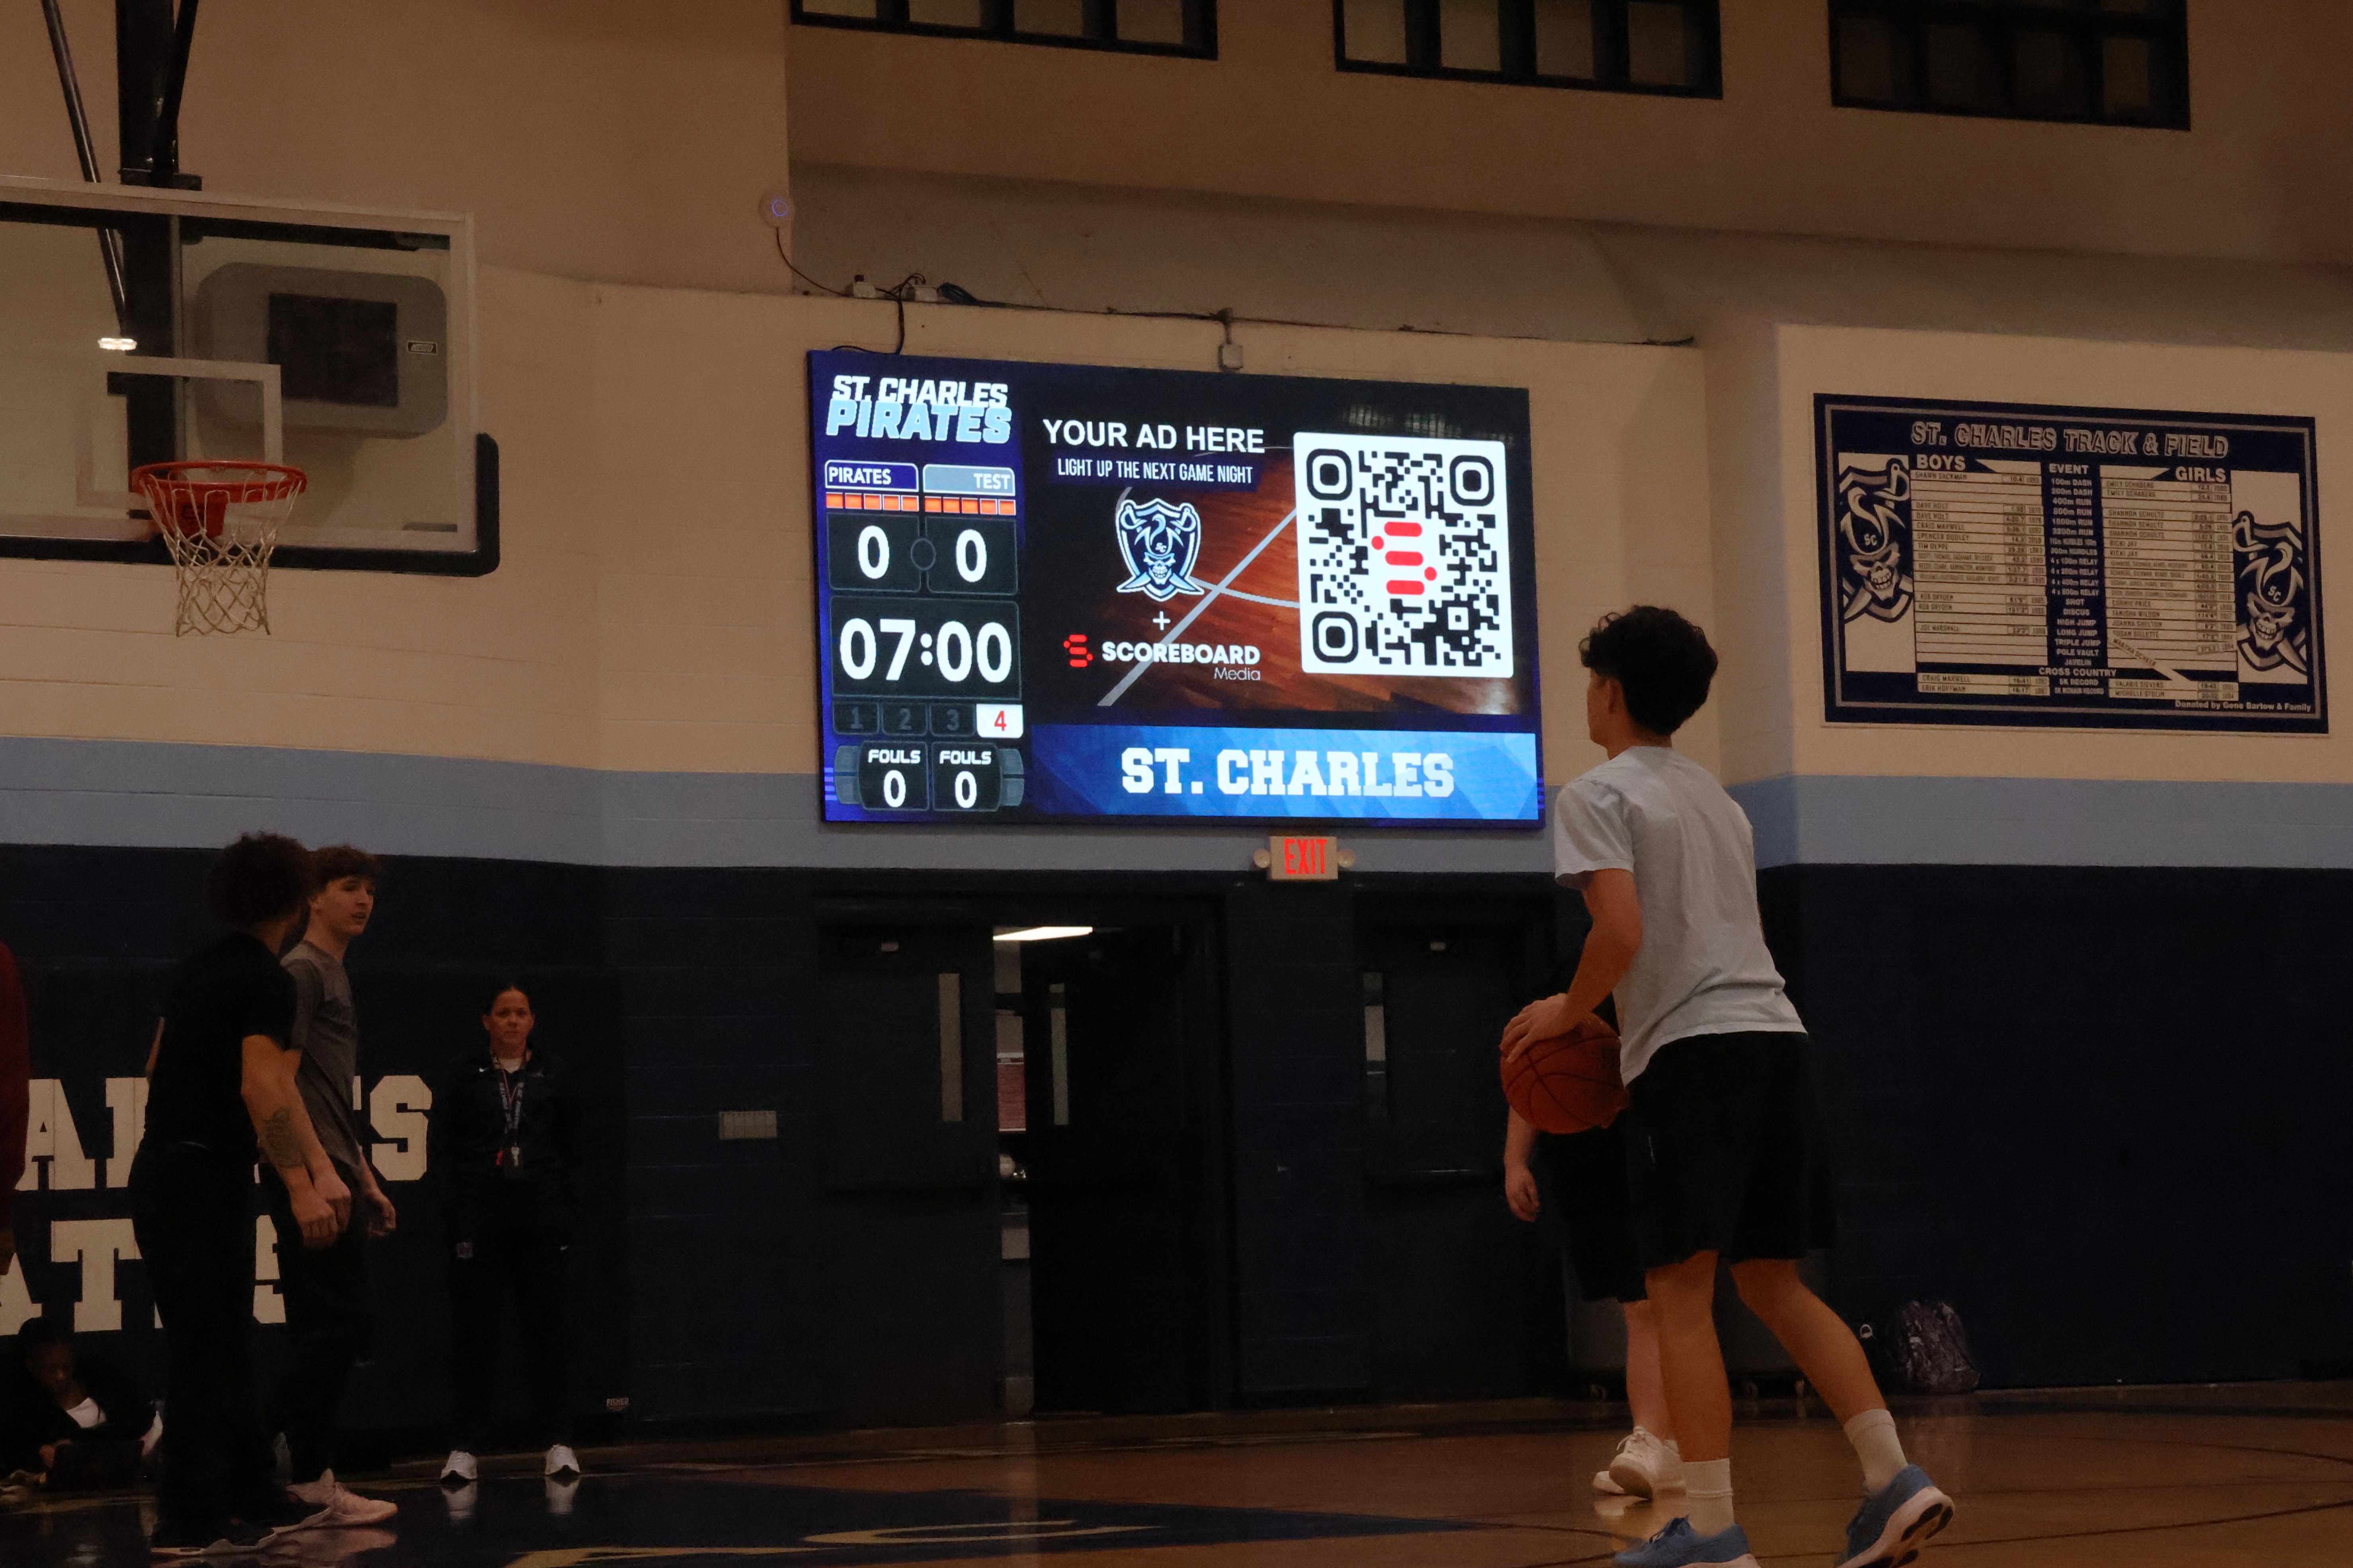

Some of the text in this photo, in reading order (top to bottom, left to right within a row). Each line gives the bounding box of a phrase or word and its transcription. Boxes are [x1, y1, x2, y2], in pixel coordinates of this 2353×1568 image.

[832, 375, 1008, 408] ST. CHARLES
[826, 398, 1011, 443] PIRATES
[1043, 419, 1265, 453] YOUR AD HERE
[1911, 421, 2228, 458] ST. CHARLES TRACK & FIELD
[1058, 458, 1253, 484] LIGHT UP THE NEXT GAME NIGHT
[1917, 454, 1966, 470] BOYS
[2049, 464, 2089, 474] EVENT
[829, 467, 891, 485] PIRATES
[974, 473, 1010, 490] TEST
[2175, 466, 2226, 482] GIRLS
[1155, 542, 1167, 554] SC
[1864, 533, 1877, 546] SC
[858, 526, 889, 579] 0
[956, 529, 986, 582] 0
[2267, 585, 2281, 602] SC
[840, 618, 1012, 683] 07:00
[1102, 642, 1260, 664] SCOREBOARD
[1214, 667, 1261, 681] Media
[2039, 667, 2117, 677] CROSS COUNTRY
[2175, 700, 2209, 708] Donated
[2211, 701, 2220, 710] by
[2285, 703, 2311, 712] Family
[851, 707, 1006, 731] 1 2 3 4
[868, 749, 921, 763] FOULS
[939, 751, 992, 764] FOULS
[1121, 748, 1454, 797] ST. CHARLES
[884, 770, 906, 807] 0
[955, 771, 977, 808] 0
[1285, 839, 1327, 874] EXIT
[607, 1398, 629, 1407] FISHER
